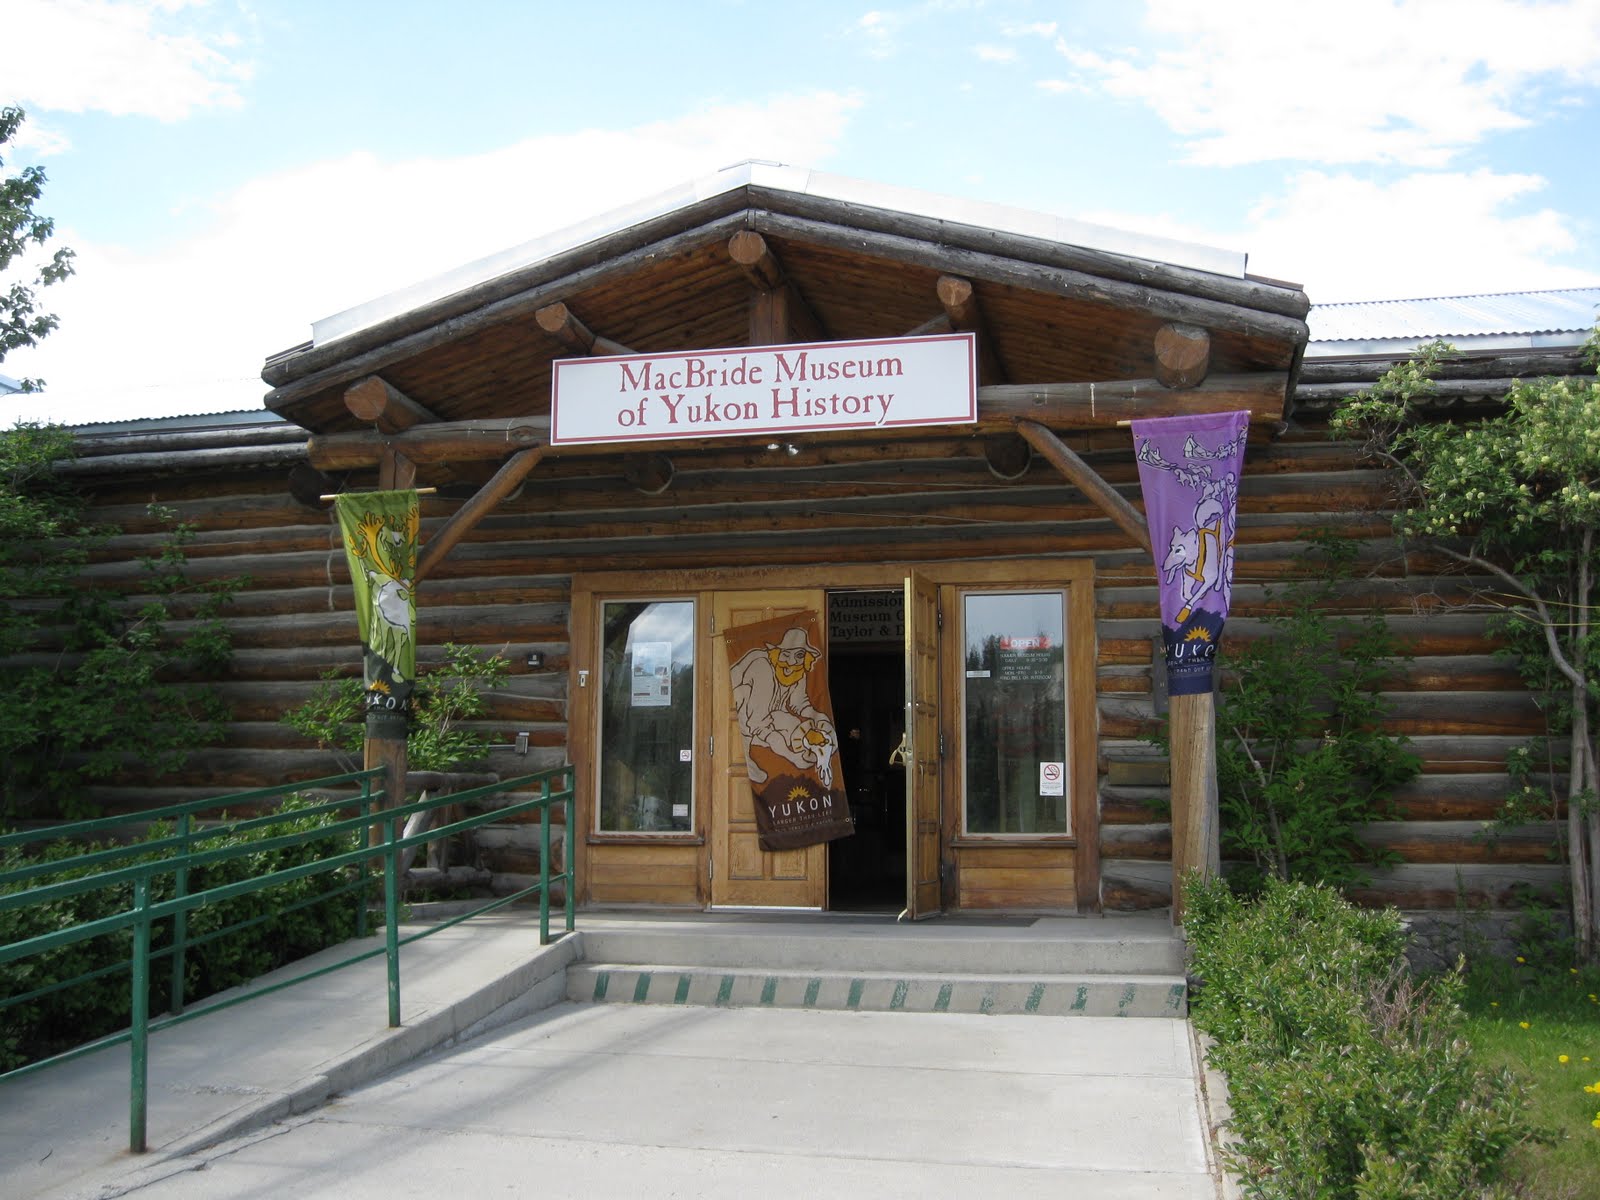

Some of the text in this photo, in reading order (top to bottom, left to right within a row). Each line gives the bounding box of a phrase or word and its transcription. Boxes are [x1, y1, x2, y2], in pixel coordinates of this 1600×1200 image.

[619, 350, 903, 393] MacBride Museum
[617, 386, 895, 428] of Yukon History
[831, 611, 891, 623] Museum
[831, 625, 874, 640] Taylor
[879, 624, 889, 636] &
[1010, 639, 1040, 648] OPEN
[1166, 642, 1215, 659] UKO
[768, 794, 833, 819] YUKON
